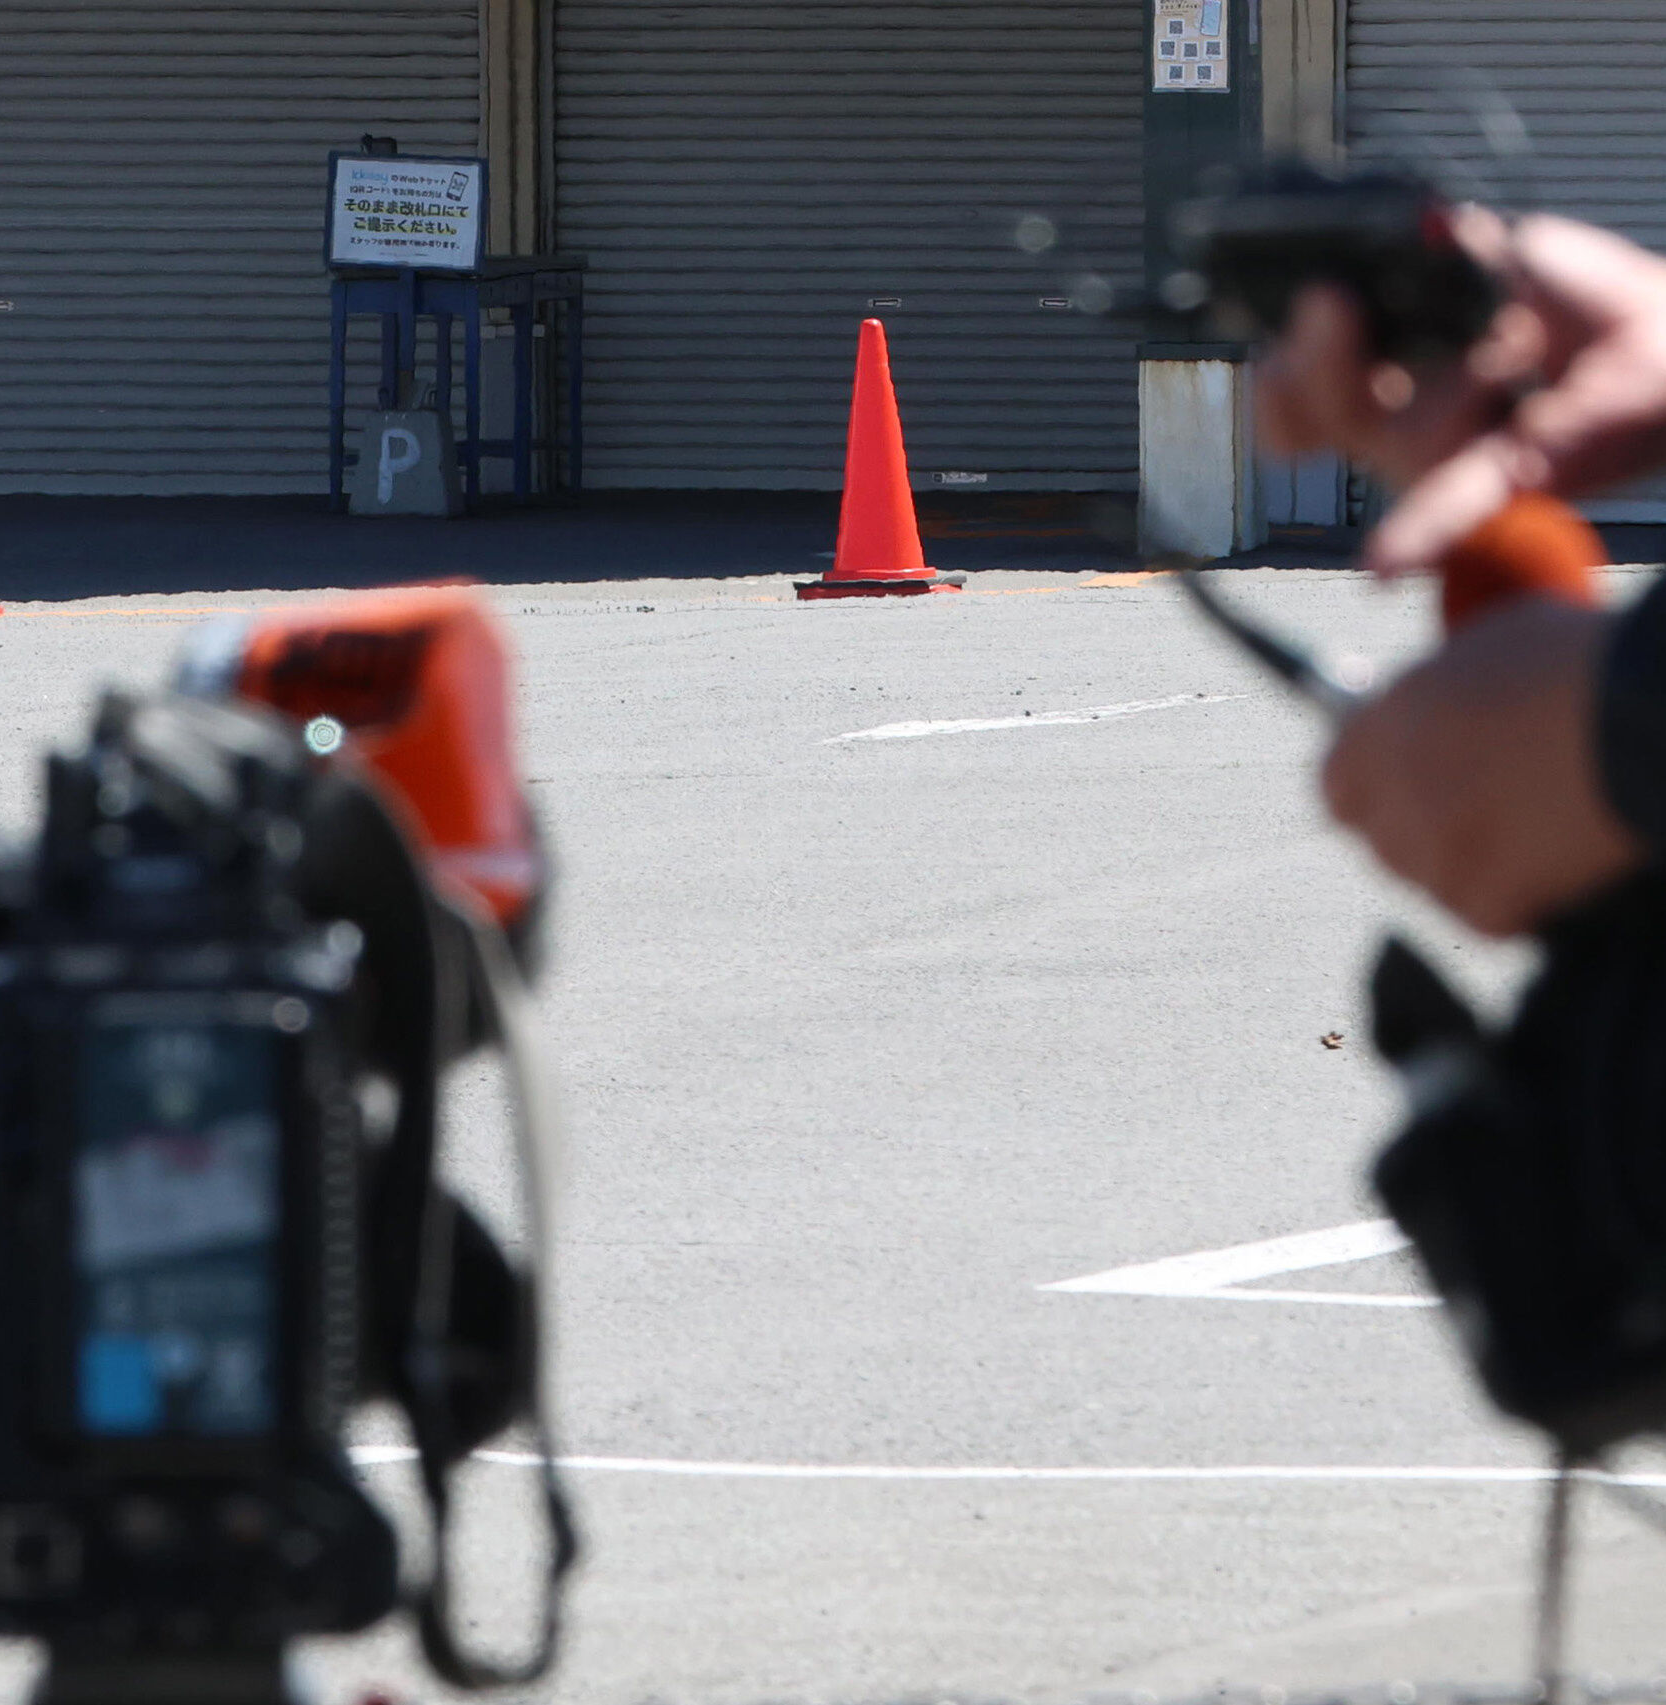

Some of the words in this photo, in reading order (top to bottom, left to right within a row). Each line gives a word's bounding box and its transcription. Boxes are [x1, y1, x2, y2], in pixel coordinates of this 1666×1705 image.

[344, 198, 470, 218] そのまま改札口にて
[353, 216, 457, 235] ご提示ください。
[377, 427, 422, 505] P
